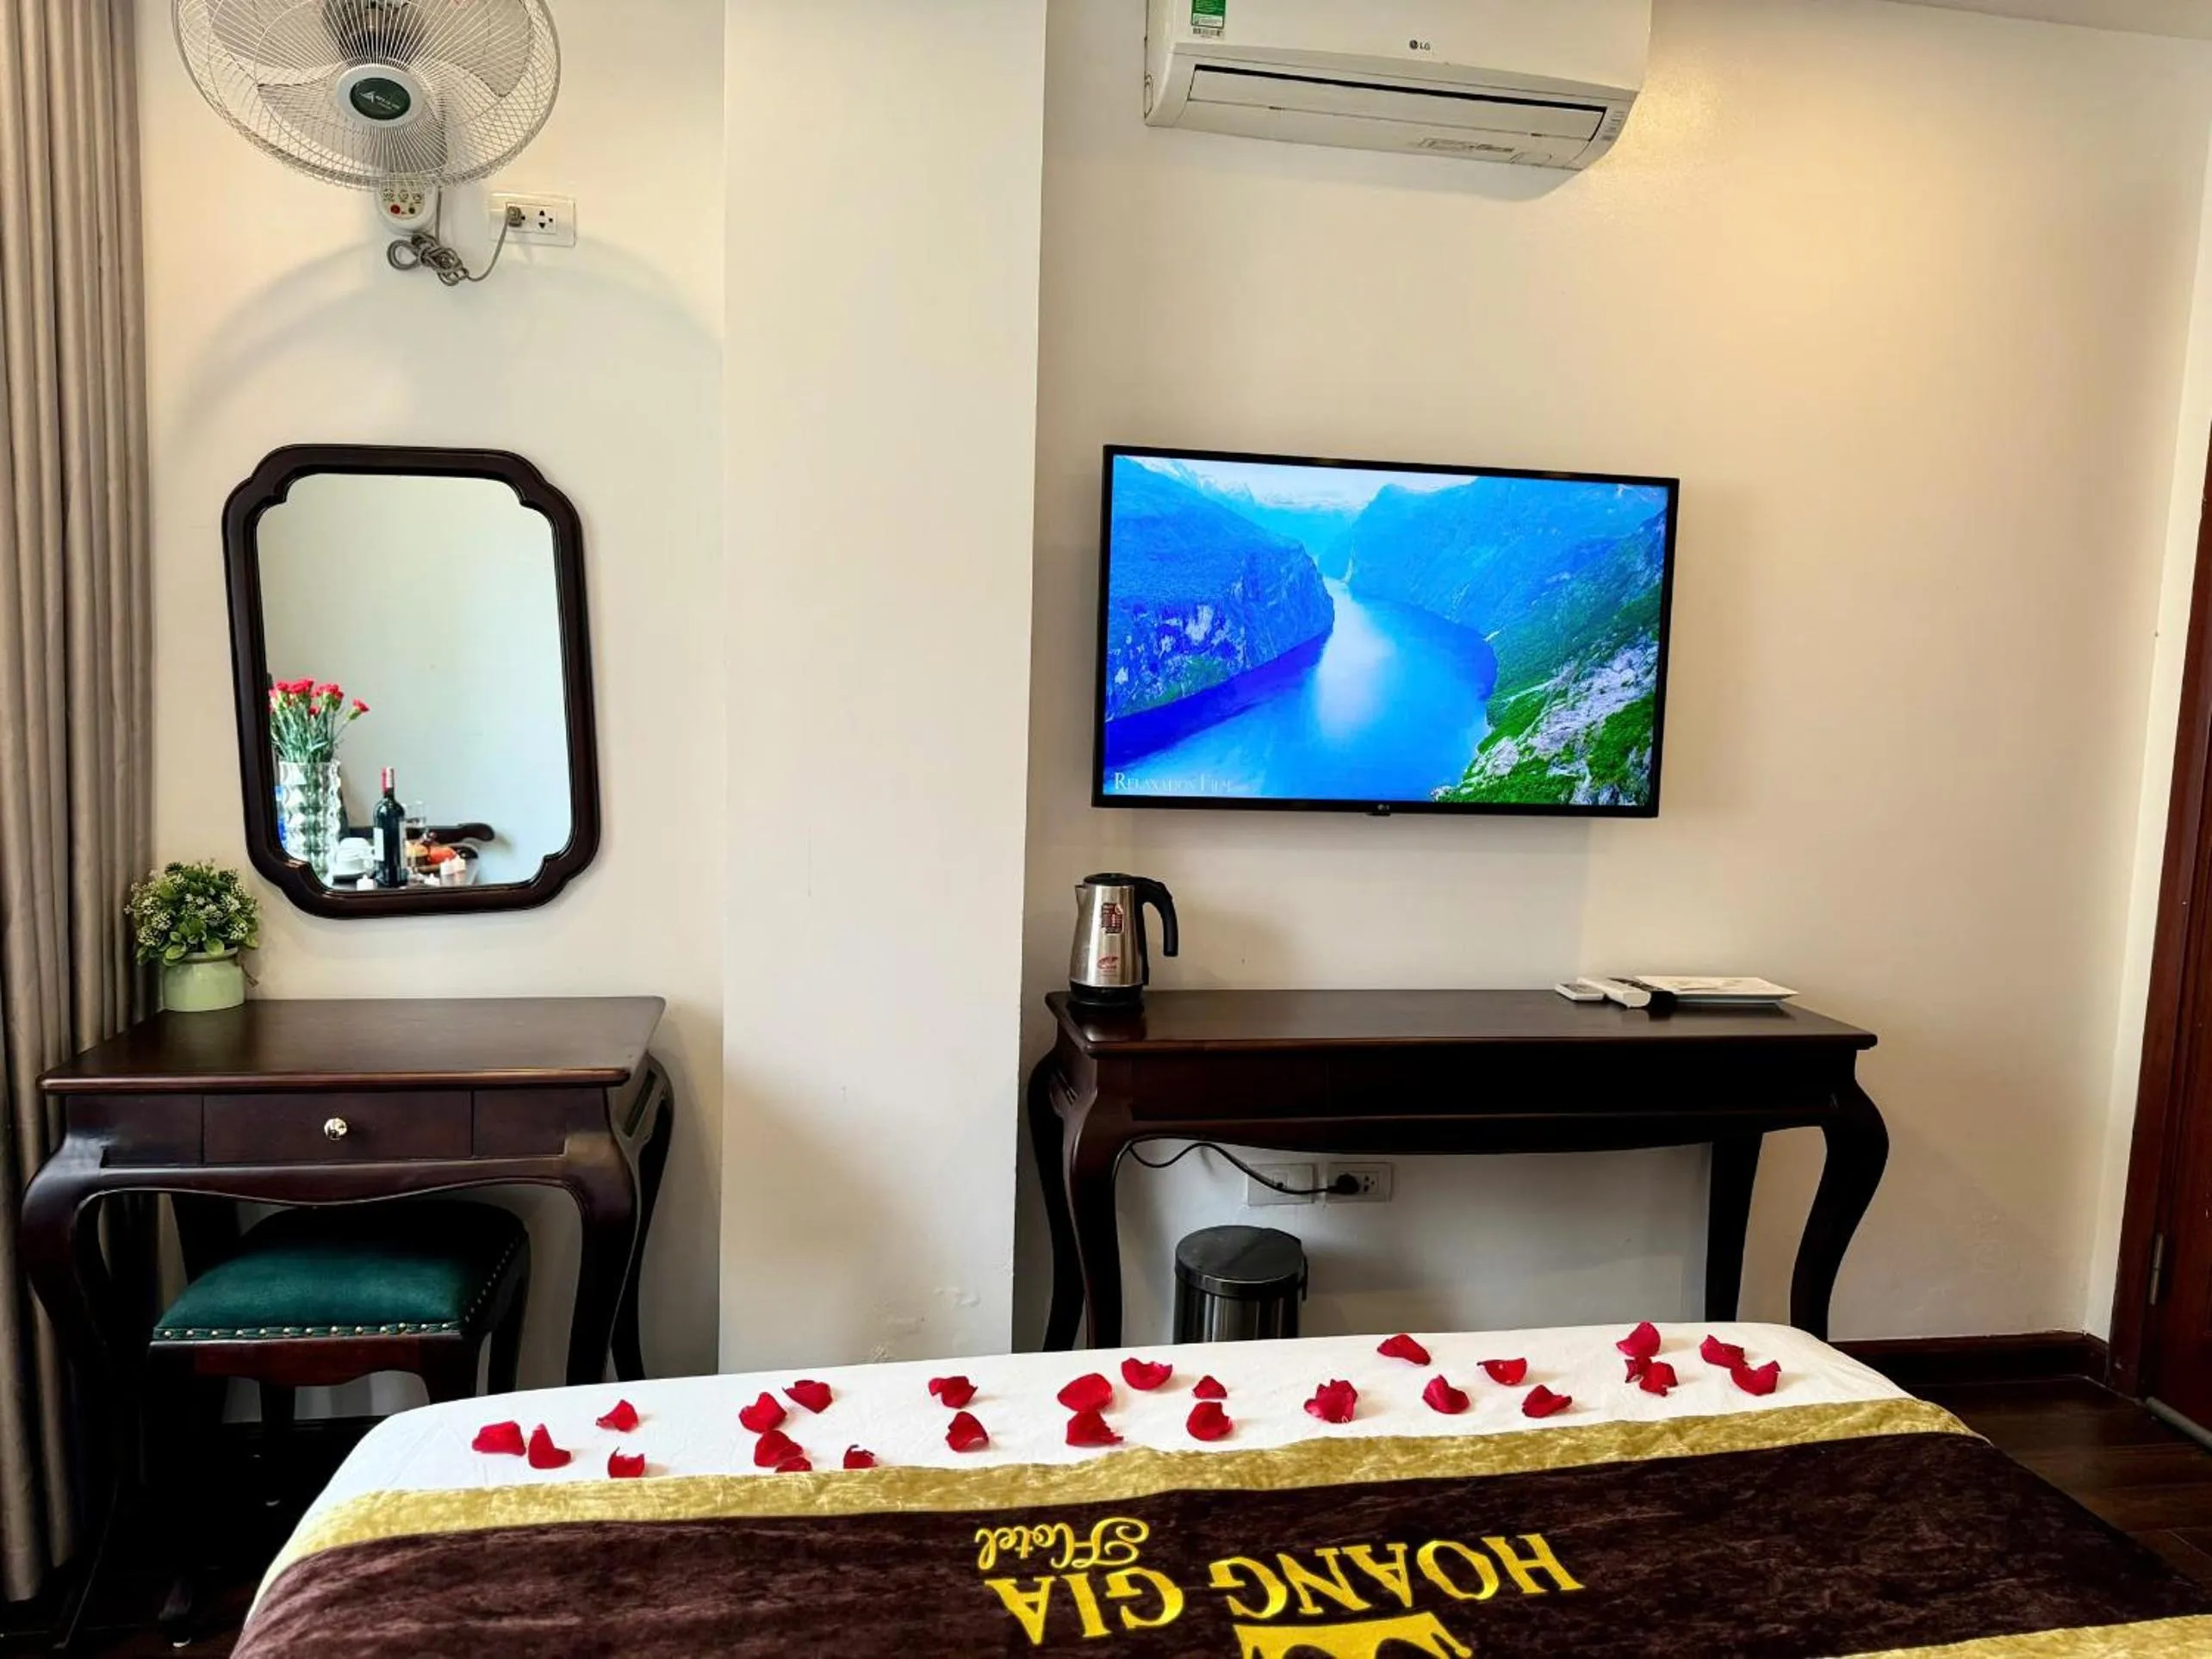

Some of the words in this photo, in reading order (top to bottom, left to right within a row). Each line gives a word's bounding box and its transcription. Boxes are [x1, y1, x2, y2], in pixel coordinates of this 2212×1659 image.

[974, 1517, 1150, 1570] Hotel
[1209, 1533, 1585, 1619] HOANG
[984, 1566, 1184, 1646] GIA
